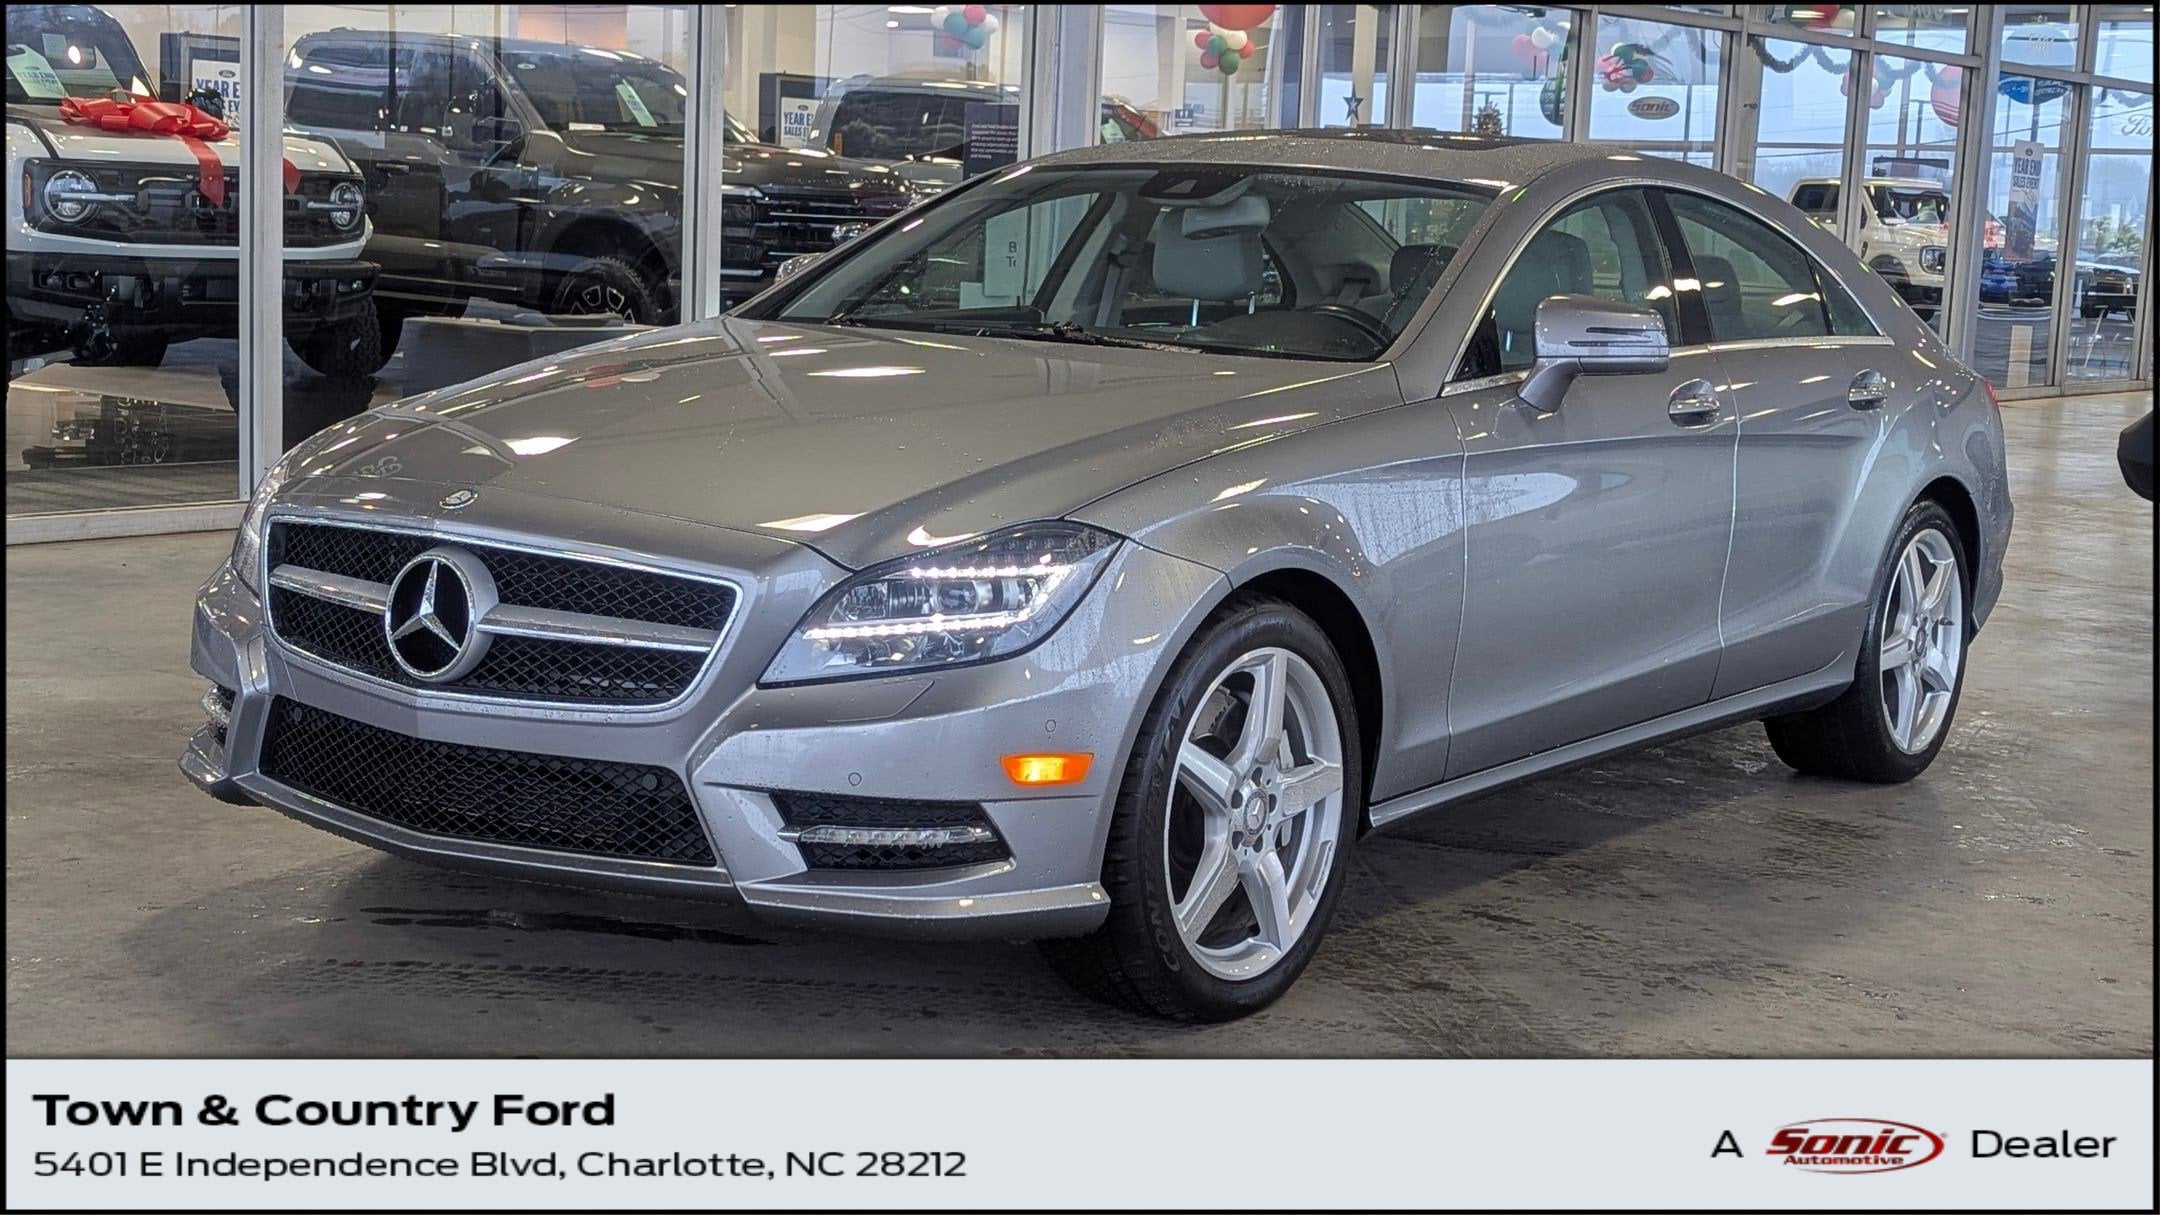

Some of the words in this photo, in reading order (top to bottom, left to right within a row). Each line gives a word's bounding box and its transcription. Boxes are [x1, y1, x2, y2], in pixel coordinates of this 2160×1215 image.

[1629, 101, 1672, 112] Sonic
[784, 112, 805, 126] YEAR
[784, 126, 802, 137] SALES
[2014, 157, 2030, 175] YEAR
[2029, 159, 2042, 176] END
[2013, 175, 2026, 188] SALES
